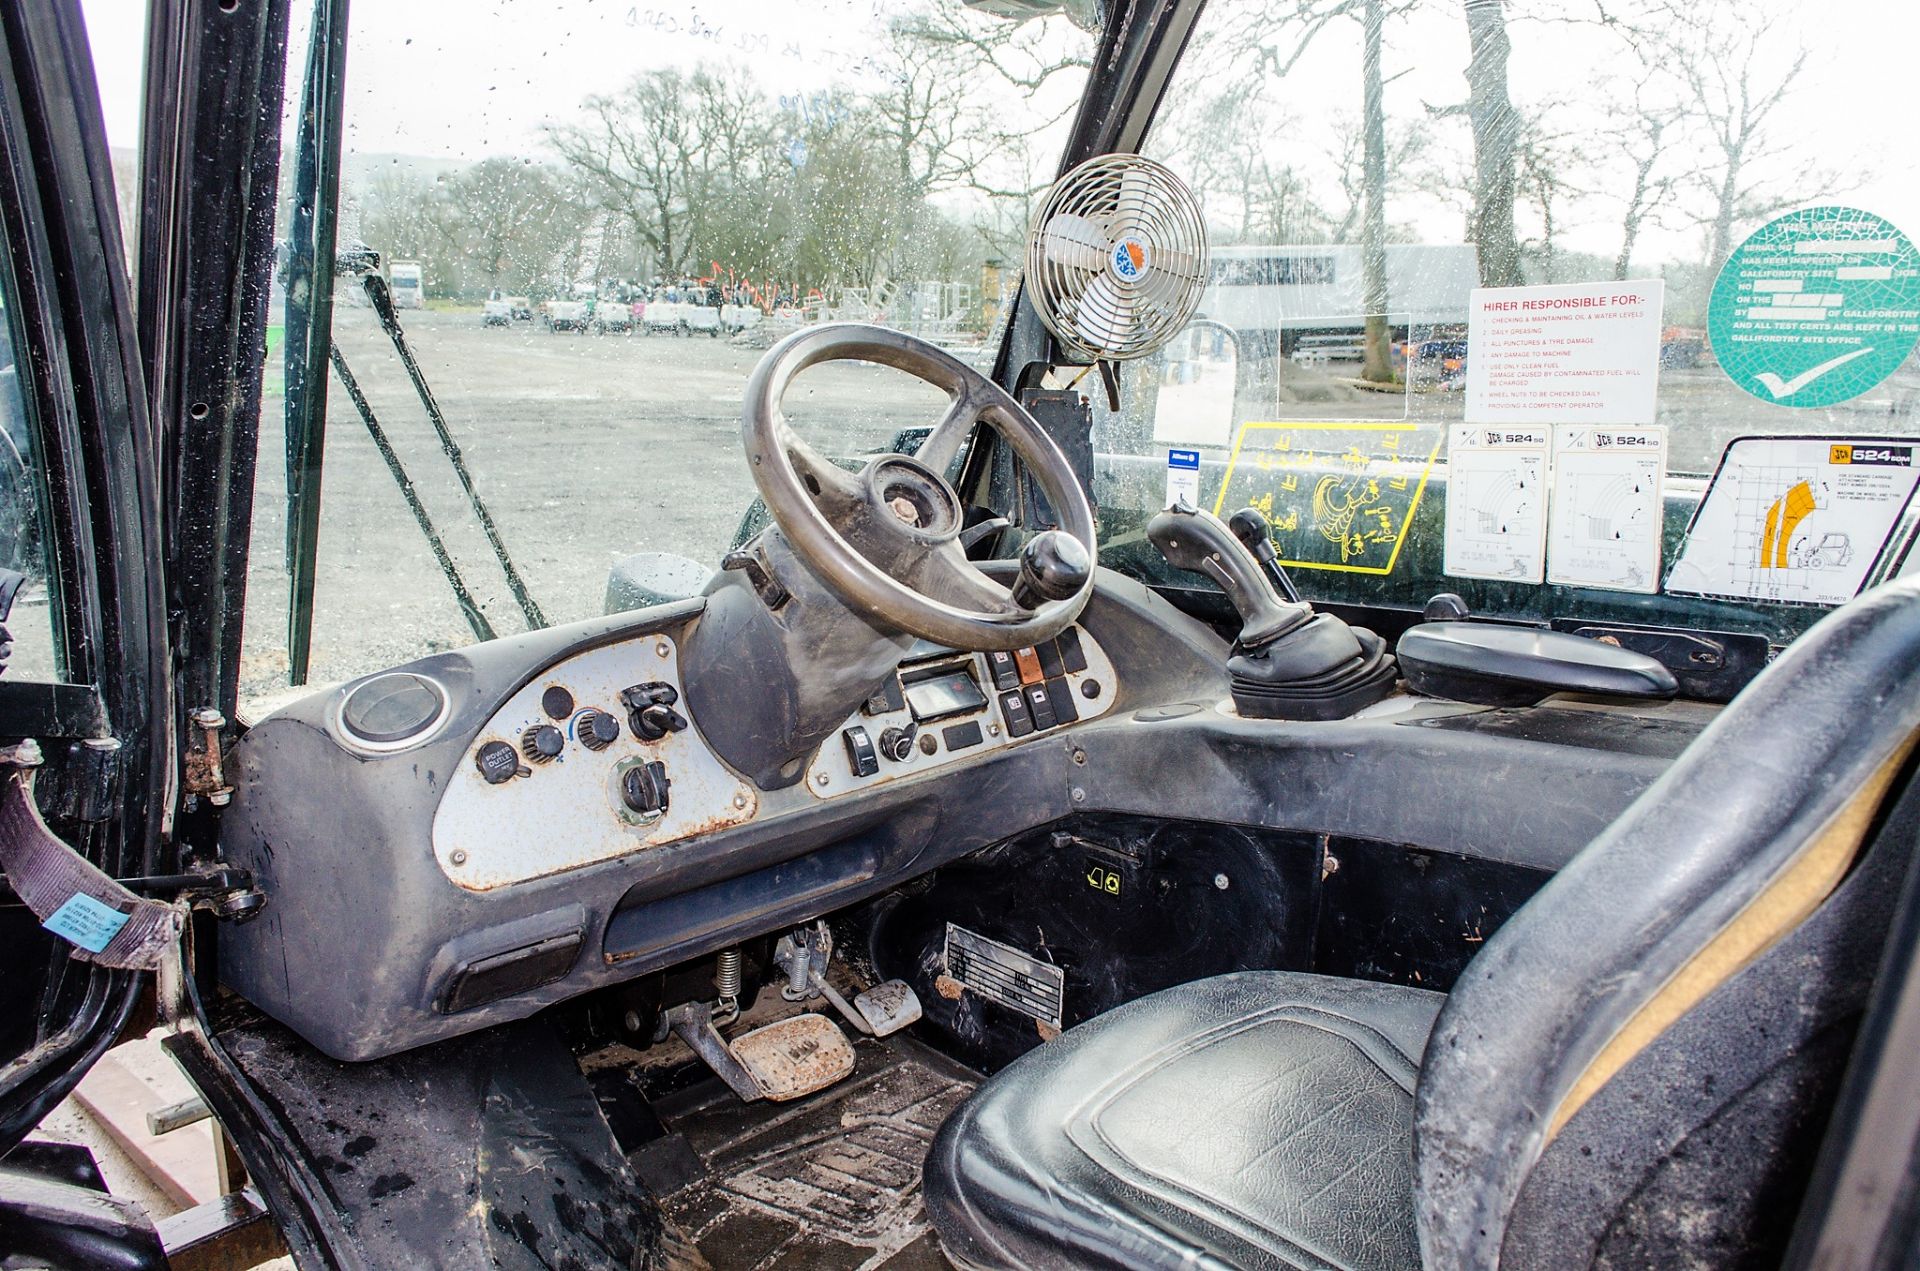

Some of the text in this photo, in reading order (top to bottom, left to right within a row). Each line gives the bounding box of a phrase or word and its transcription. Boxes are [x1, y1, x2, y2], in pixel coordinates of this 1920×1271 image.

[1483, 301, 1518, 312] HIRER
[1522, 296, 1606, 311] RESPONSIBLE
[1736, 296, 1772, 304] ON THE
[1491, 316, 1523, 324] CHECKING
[1531, 314, 1573, 323] MAINTAINING
[1594, 312, 1618, 320] WATER
[1619, 311, 1644, 319] LEVELS
[1732, 322, 1754, 330] AND
[1754, 322, 1772, 330] ALL
[1773, 322, 1797, 330] TEST
[1799, 323, 1831, 331] CERTS
[1503, 338, 1541, 347] PUNCTURES
[1566, 337, 1594, 345] DAMAGE
[1802, 335, 1825, 344] SITE
[1826, 336, 1862, 345] OFFICE
[1543, 361, 1559, 369] FUEL
[1517, 370, 1543, 378] CAUSED
[1553, 369, 1605, 377] CONTAMINATED
[1549, 390, 1581, 398] CHECKED
[1569, 401, 1604, 409] OPERATOR
[1486, 432, 1502, 444] JCB
[1505, 434, 1533, 443] 524
[1596, 433, 1613, 447] JCB
[1616, 436, 1646, 446] 524
[1851, 449, 1892, 461] 524
[485, 746, 511, 762] POWER
[488, 752, 514, 768] OUTLET
